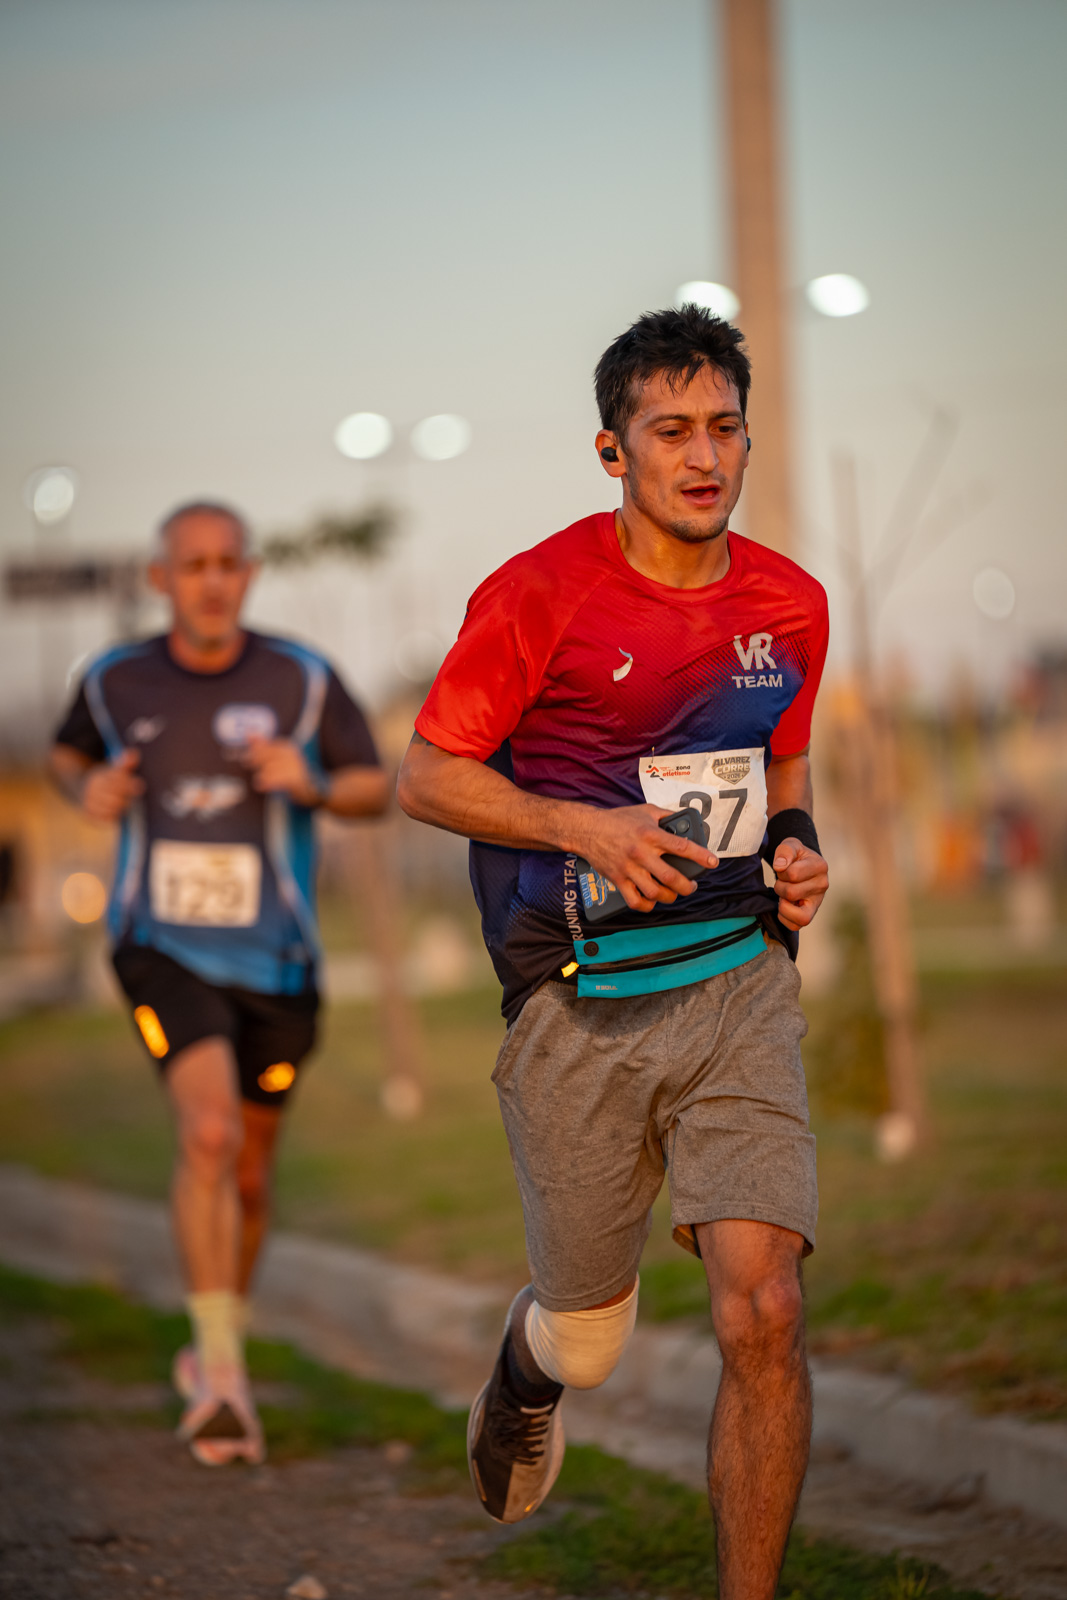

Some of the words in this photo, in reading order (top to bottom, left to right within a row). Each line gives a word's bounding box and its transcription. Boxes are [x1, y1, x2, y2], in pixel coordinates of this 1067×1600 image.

[732, 674, 783, 688] TEAM
[713, 756, 751, 767] ALVAREZ
[715, 763, 750, 775] CORRE
